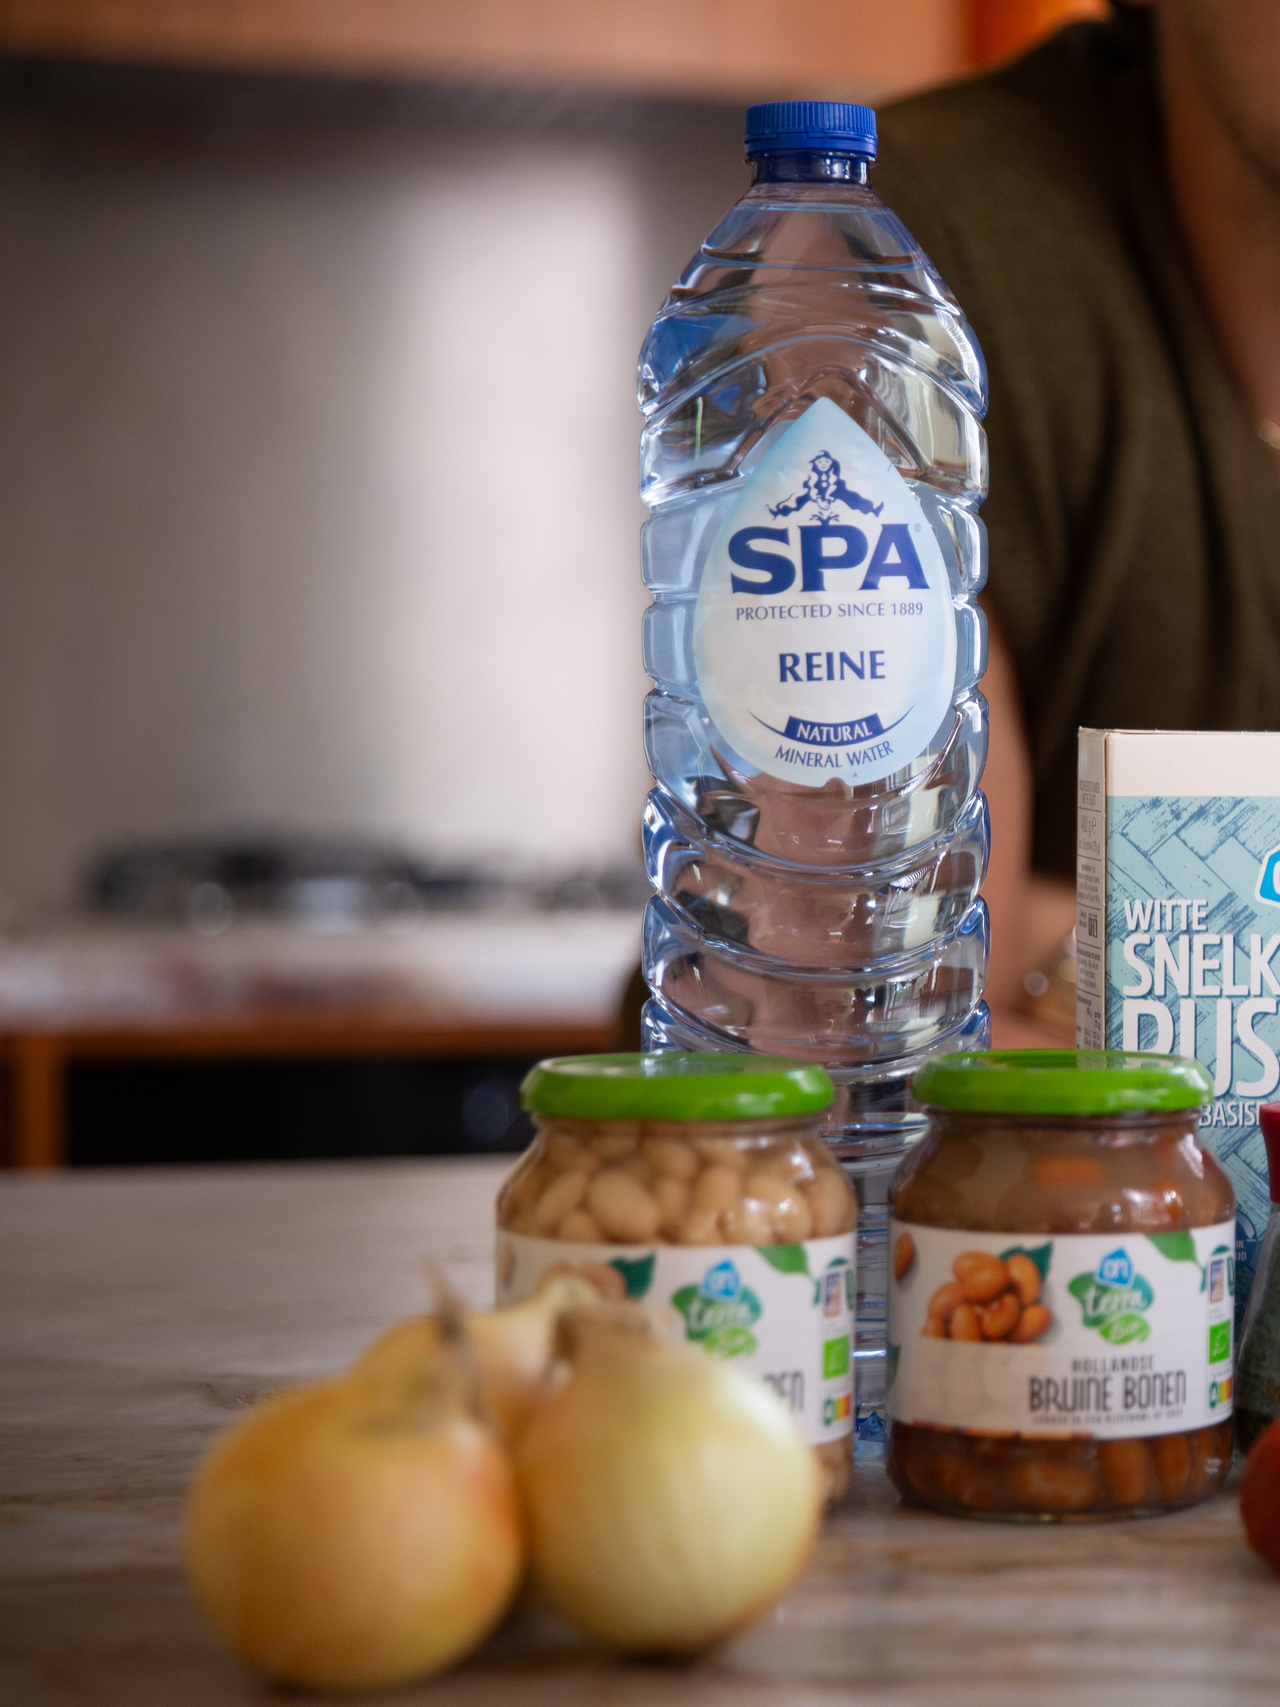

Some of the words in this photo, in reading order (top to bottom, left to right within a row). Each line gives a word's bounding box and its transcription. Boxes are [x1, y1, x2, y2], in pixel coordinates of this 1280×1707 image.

[728, 523, 931, 595] SPA
[736, 604, 832, 621] PROTECTED
[838, 602, 886, 617] SINCE
[890, 601, 923, 616] 1889
[779, 650, 886, 683] REINE
[796, 721, 873, 743] NATURAL
[775, 744, 843, 768] MINERAL
[846, 740, 894, 766] WATER
[1123, 899, 1208, 931] WITTE
[1198, 1101, 1261, 1127] BASIS
[1072, 1355, 1154, 1373] HOLLANDSE
[1030, 1376, 1113, 1413] BRUINE
[1123, 1370, 1187, 1410] BONEN
